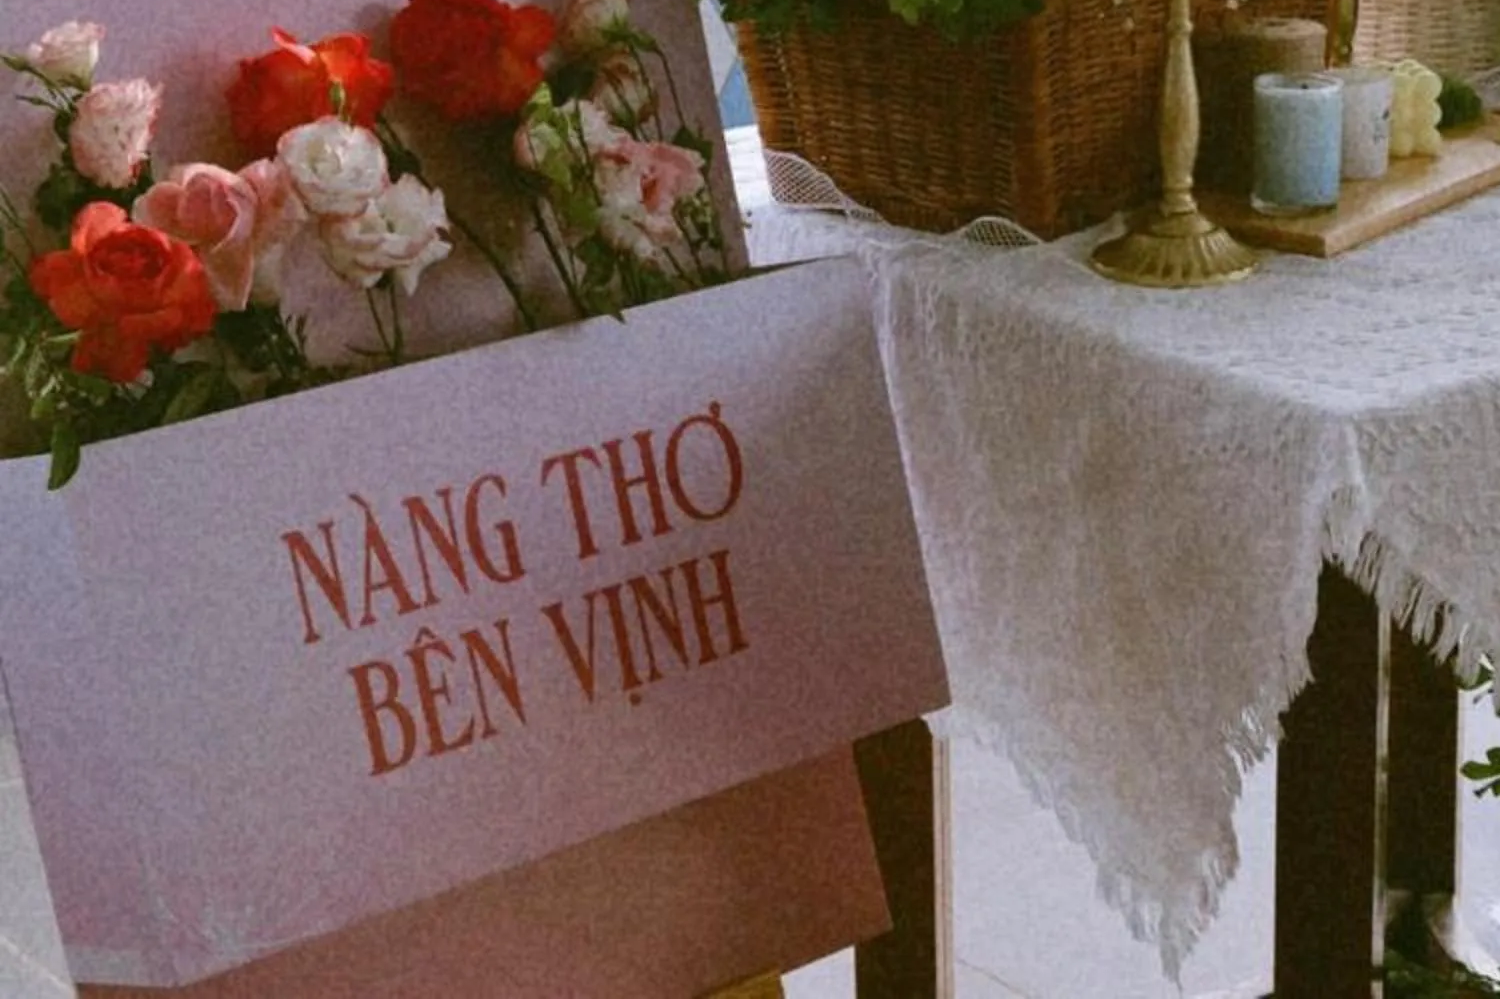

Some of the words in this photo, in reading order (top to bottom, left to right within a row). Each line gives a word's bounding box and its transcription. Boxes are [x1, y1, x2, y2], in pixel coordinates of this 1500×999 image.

[281, 472, 526, 644] NÀNG
[540, 401, 744, 560] THƠ
[348, 618, 527, 777] BÊN
[541, 549, 750, 707] VỊNH
